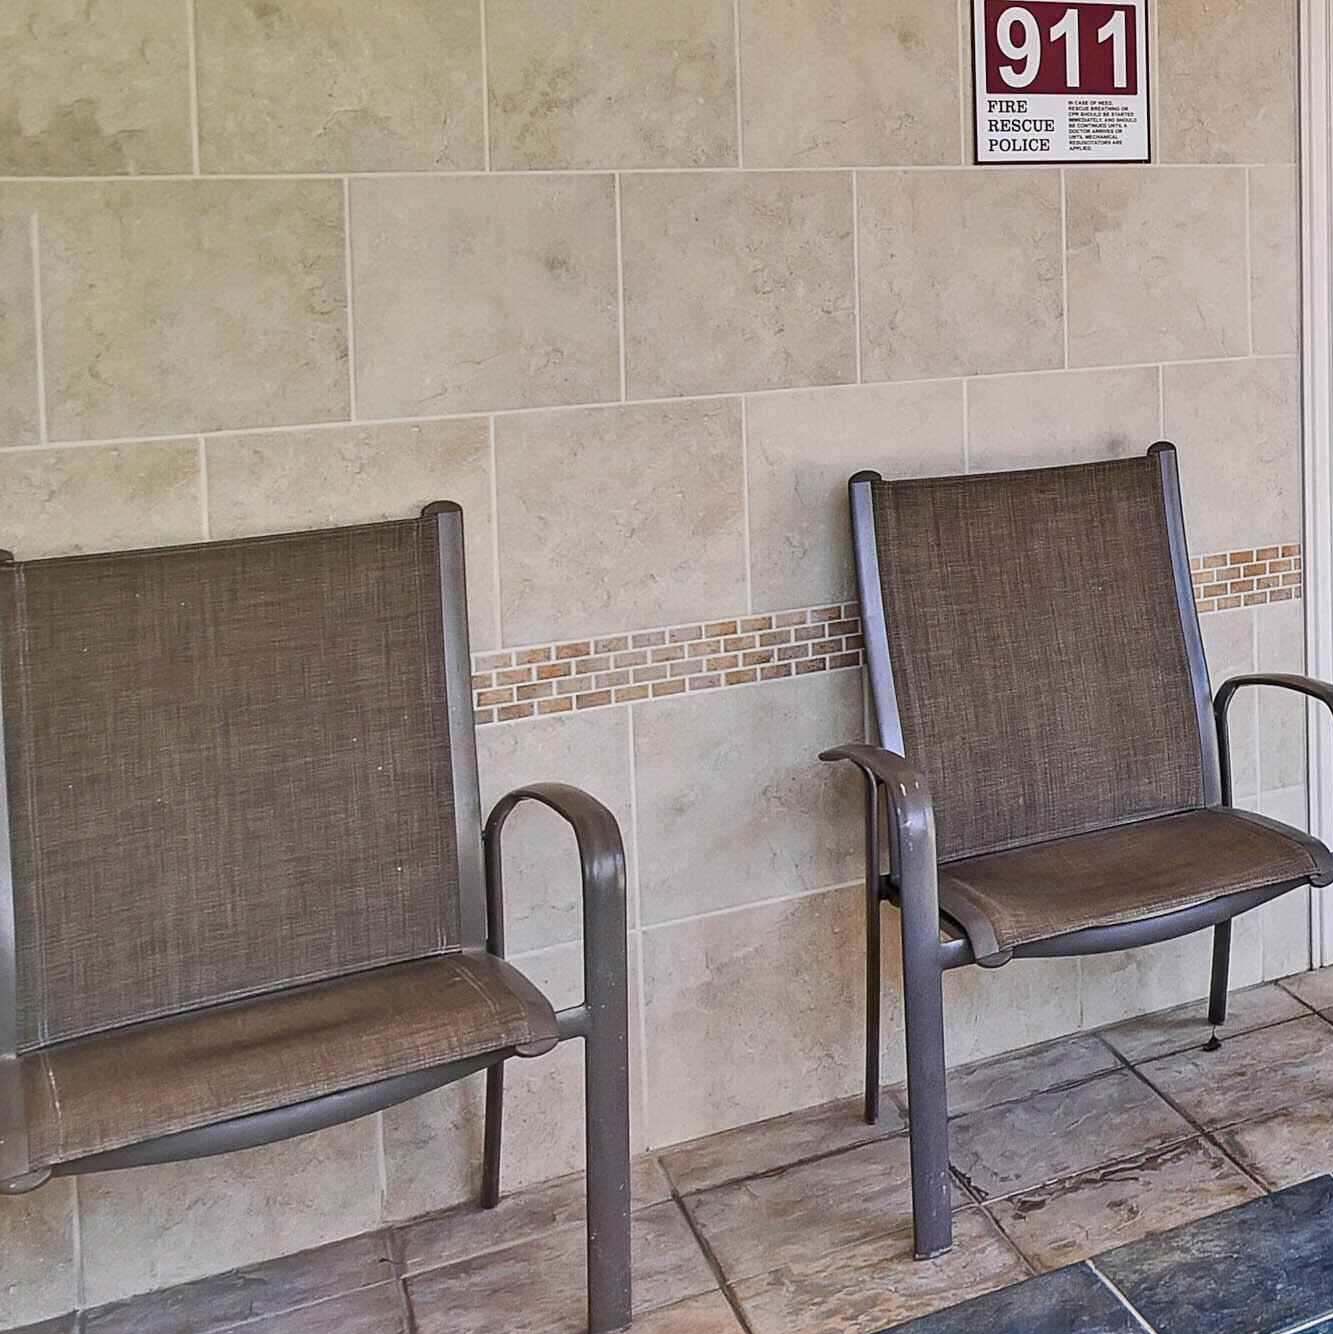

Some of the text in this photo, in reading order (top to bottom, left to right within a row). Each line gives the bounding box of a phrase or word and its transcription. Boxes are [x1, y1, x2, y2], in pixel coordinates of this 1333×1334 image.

[996, 6, 1128, 89] 911
[987, 100, 1028, 113] FIRE
[988, 119, 1055, 132] RESCUE
[989, 138, 1050, 152] POLICE
